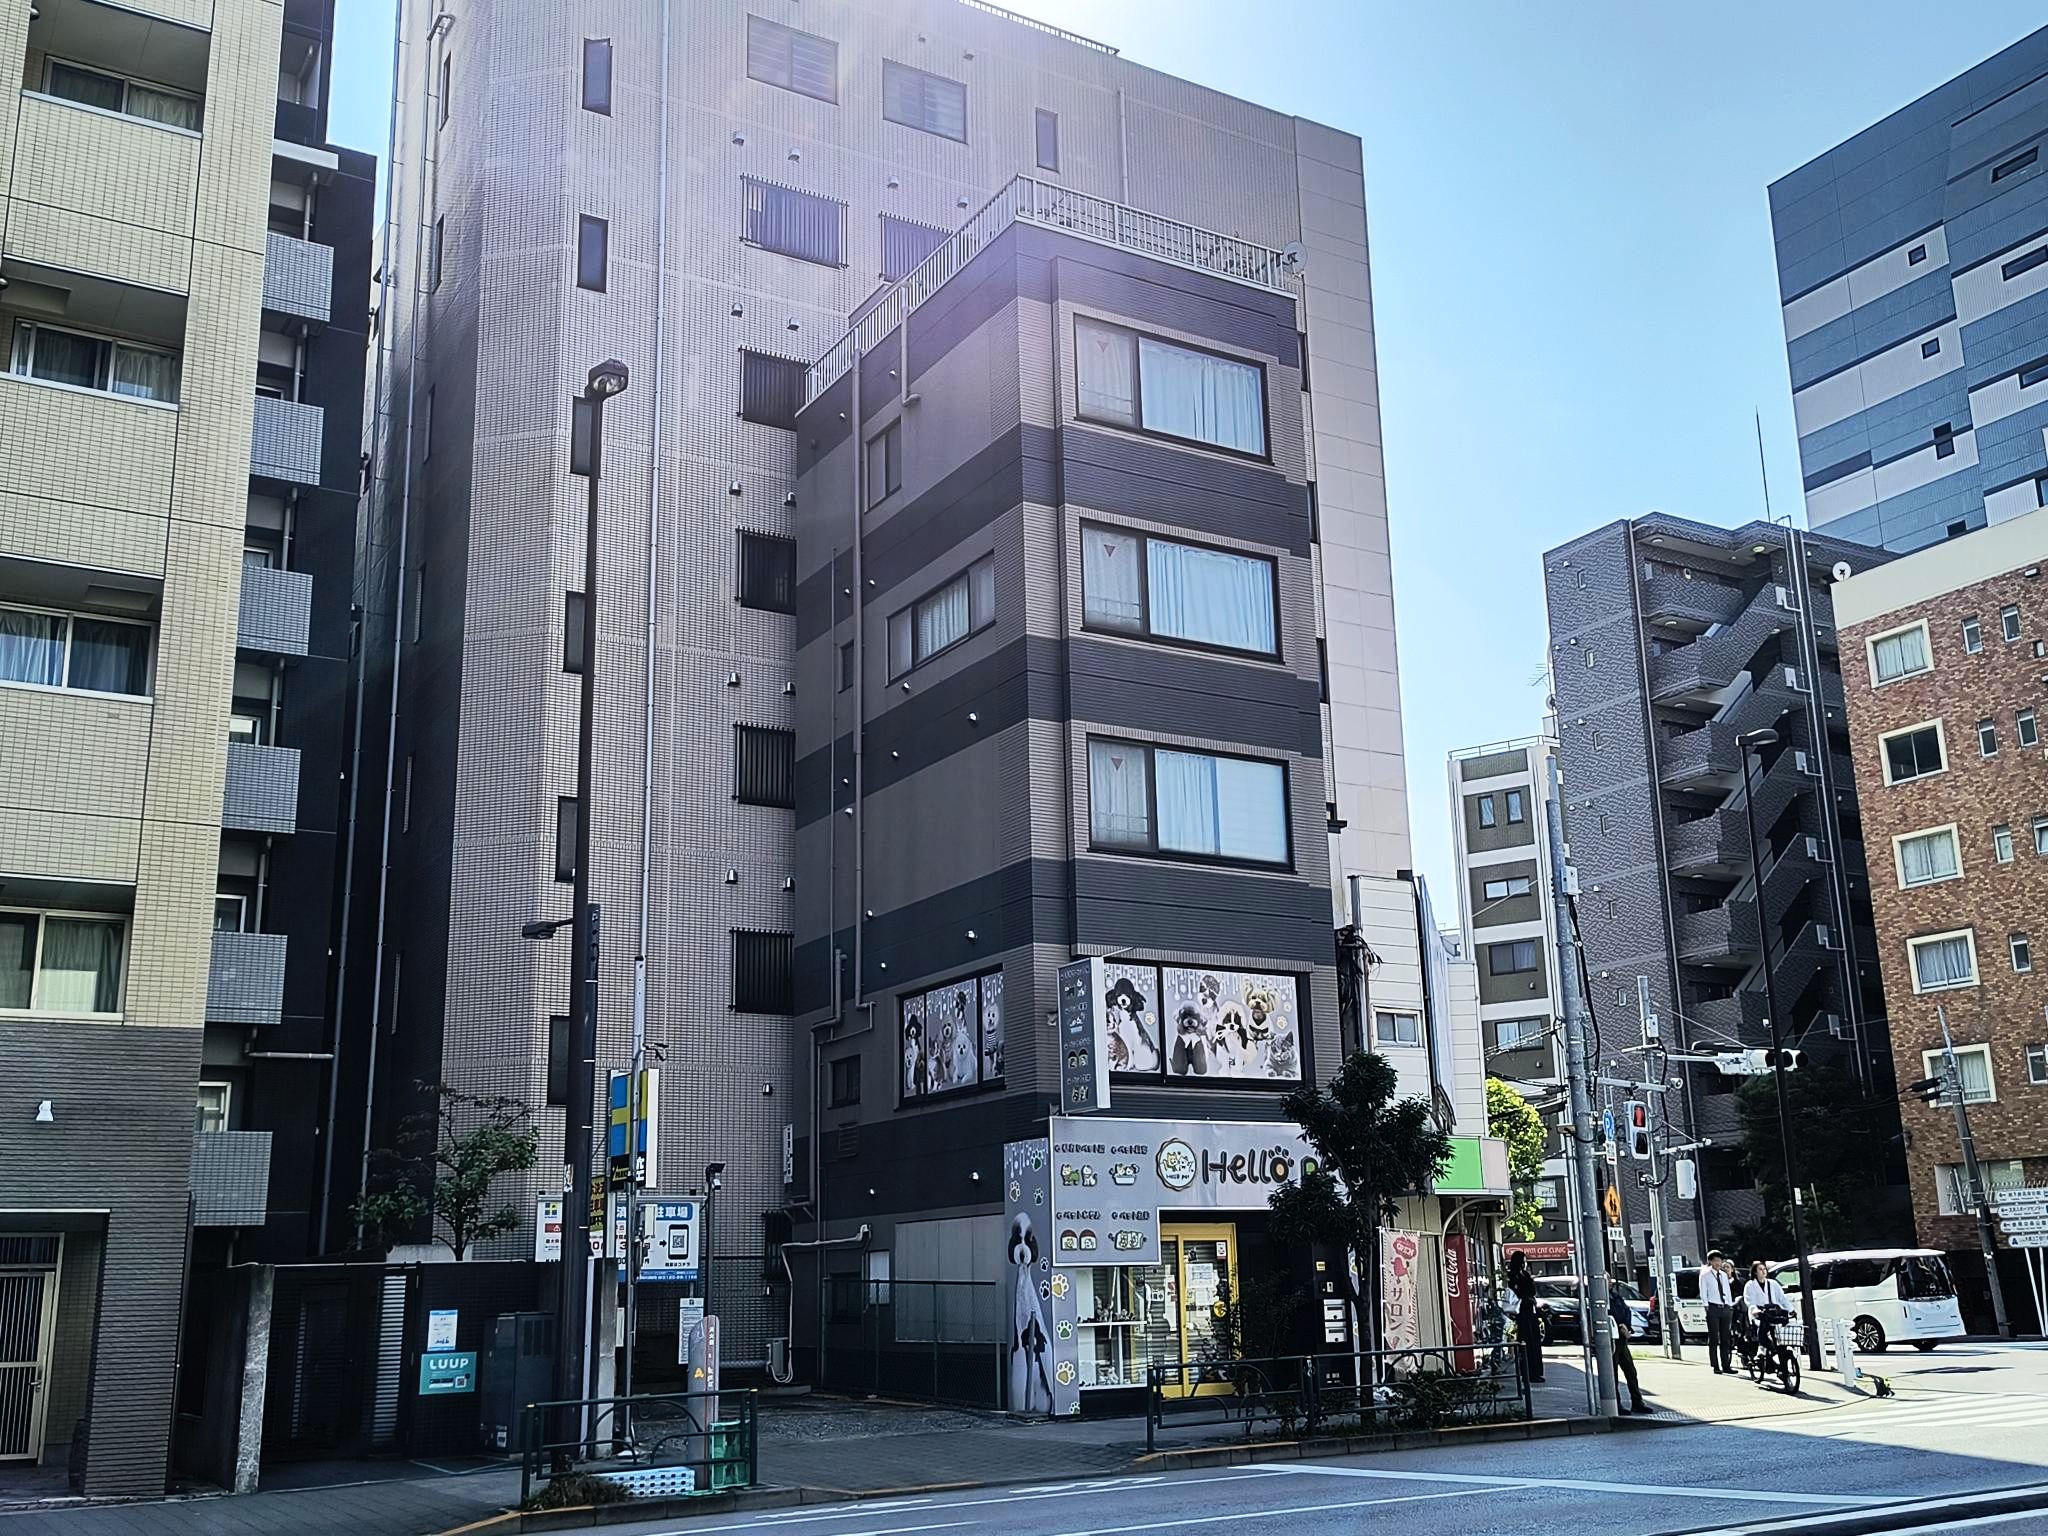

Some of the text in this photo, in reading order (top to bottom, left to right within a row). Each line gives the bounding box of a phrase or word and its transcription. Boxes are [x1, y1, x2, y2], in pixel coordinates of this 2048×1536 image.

[1202, 1146, 1293, 1184] Hello
[1390, 1287, 1404, 1331] サロン
[429, 1358, 469, 1369] LUUP
